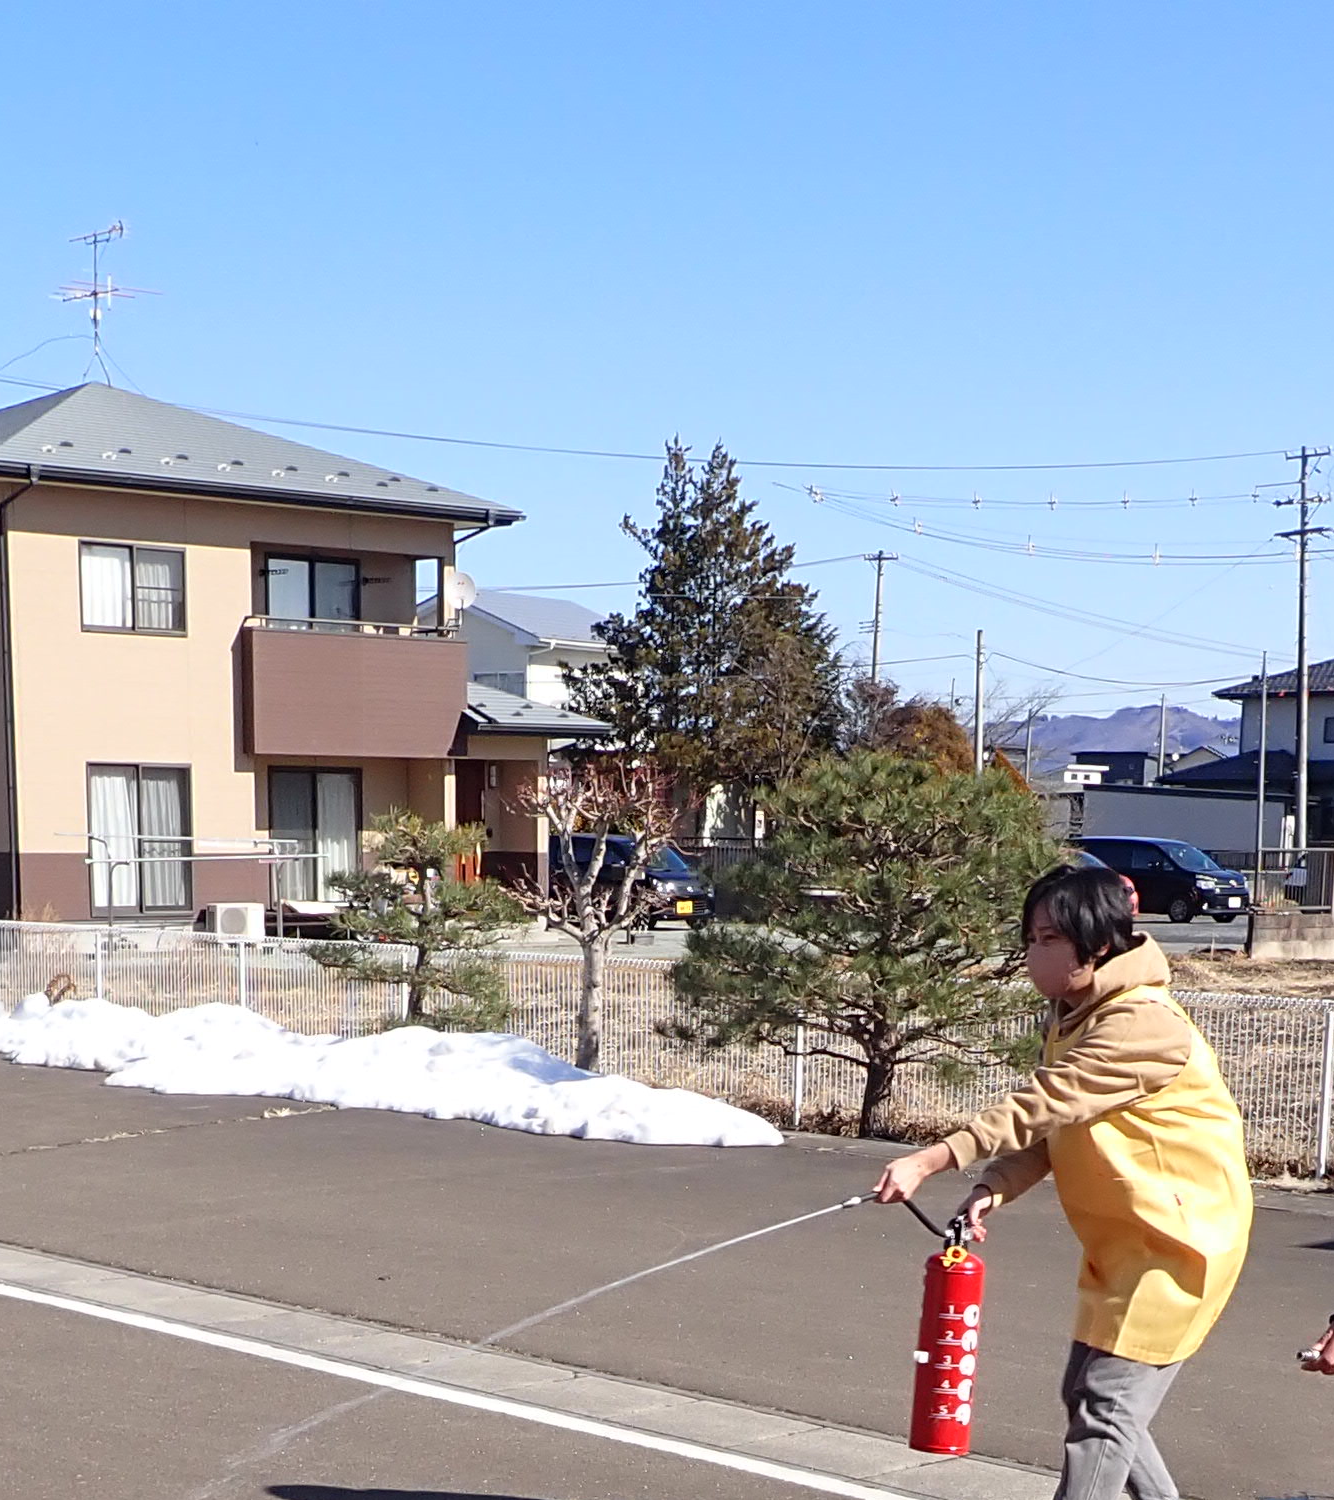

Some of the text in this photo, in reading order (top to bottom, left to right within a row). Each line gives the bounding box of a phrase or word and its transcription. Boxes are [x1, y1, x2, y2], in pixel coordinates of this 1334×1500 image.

[948, 1305, 955, 1314] 1
[945, 1331, 954, 1340] 2
[943, 1355, 952, 1365] 3
[940, 1379, 951, 1388] 4
[939, 1405, 948, 1414] 5
